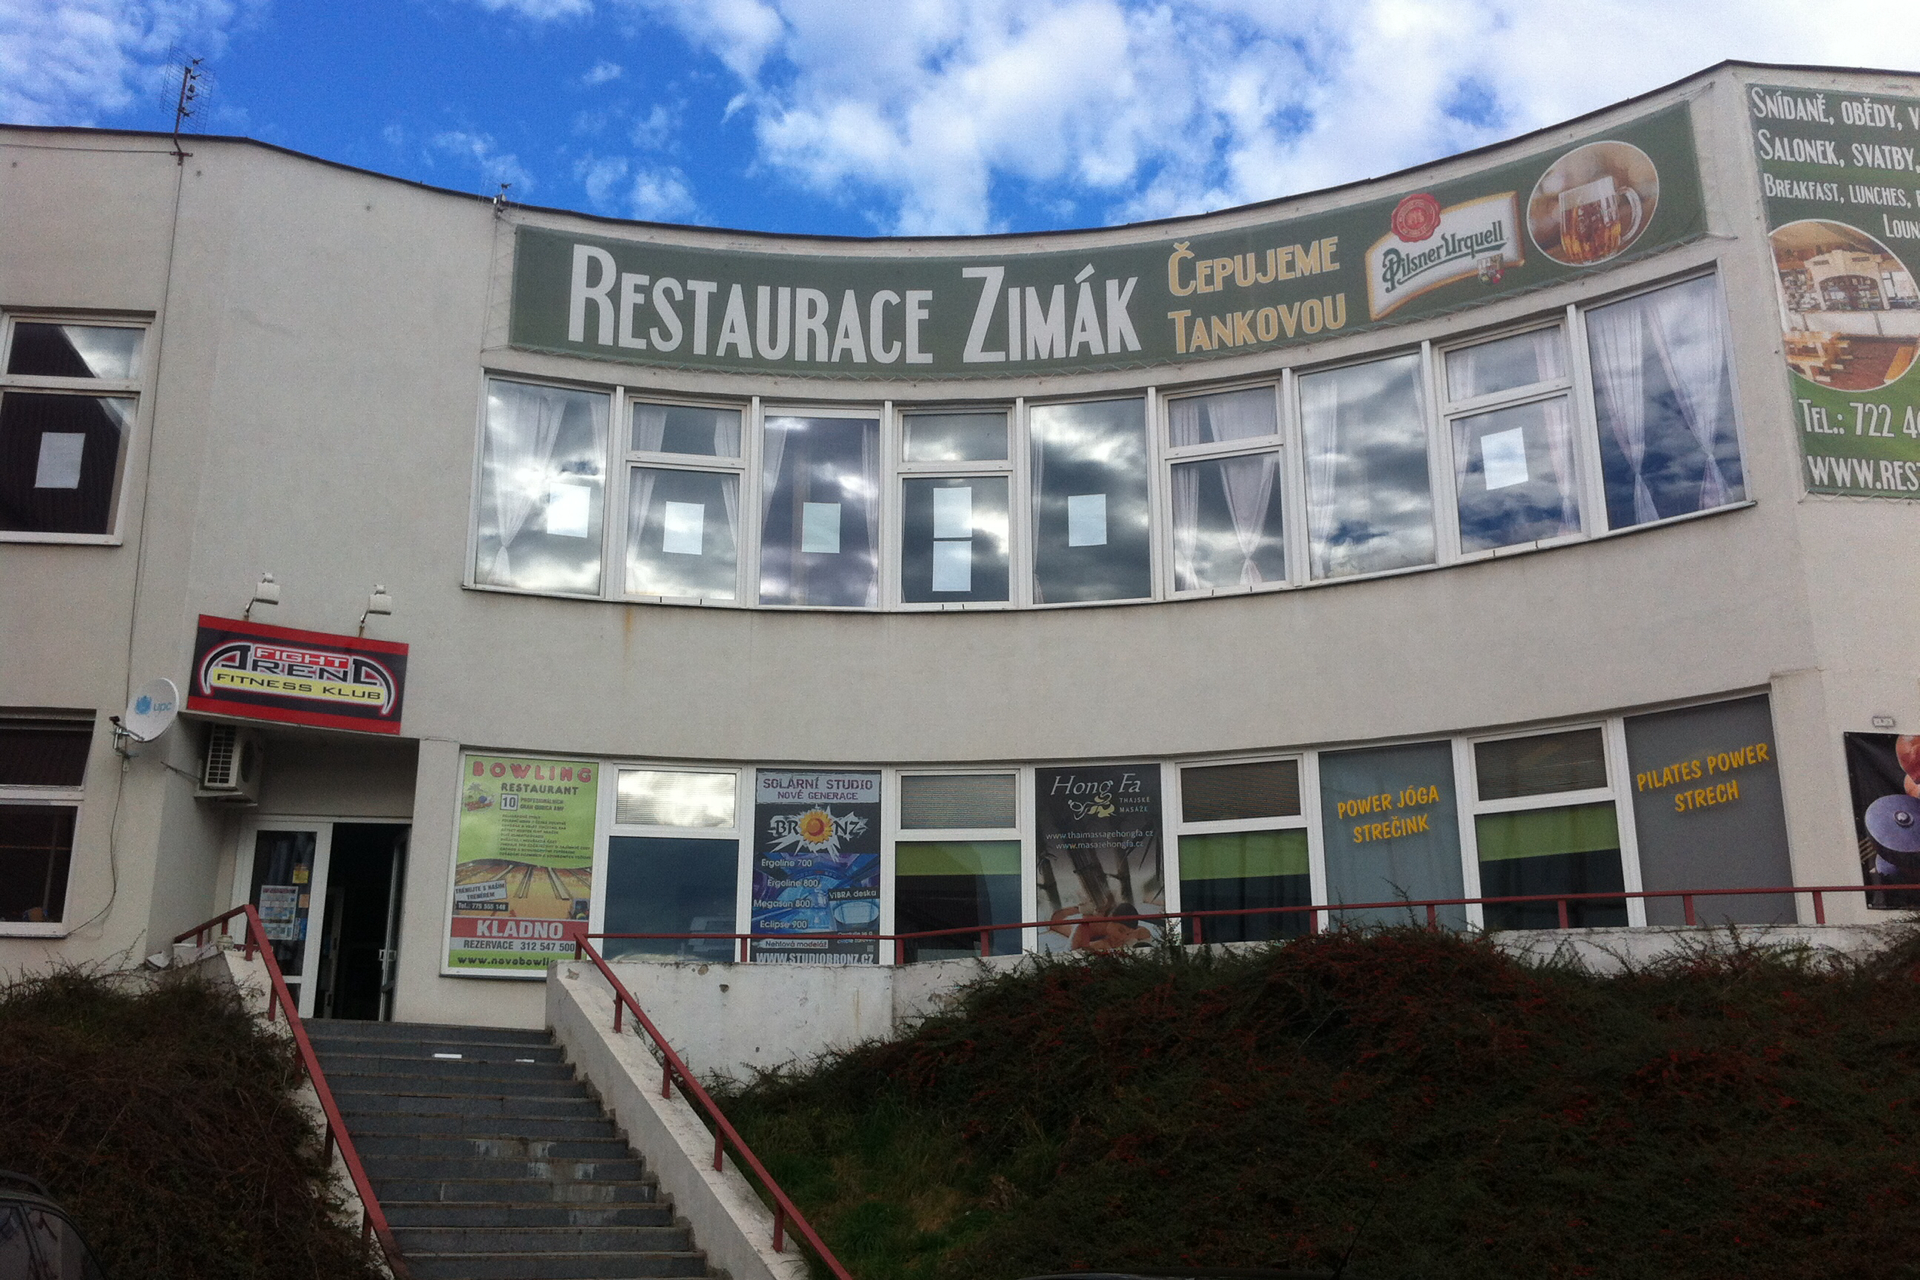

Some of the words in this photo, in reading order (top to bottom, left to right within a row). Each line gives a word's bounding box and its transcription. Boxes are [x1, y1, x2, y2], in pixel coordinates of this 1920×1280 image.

[1751, 86, 1835, 126] SNÍDANĚ,
[1841, 97, 1903, 131] OBĚDY,
[1757, 128, 1845, 168] SALONEK,
[1851, 143, 1920, 174] SVATBY,
[1763, 172, 1845, 204] BREAKFAST,
[1848, 184, 1912, 209] LUNCHES,
[1883, 213, 1920, 239] LOUN
[1167, 236, 1341, 297] ČEPUJEME
[1382, 243, 1444, 293] Pilsner
[1441, 220, 1505, 259] Urquell
[568, 243, 934, 365] RESTAURACE
[962, 262, 1142, 364] ZIMÁK
[1167, 292, 1347, 355] TANKOVOU
[1798, 398, 1845, 435] TEL.:
[1849, 402, 1895, 437] 722
[256, 647, 348, 668] FIGHT
[203, 643, 394, 713] ARENA
[216, 673, 313, 693] FITNESS
[322, 686, 381, 700] KLUB
[472, 760, 592, 783] BOWLING
[1636, 760, 1702, 792] PILATES
[1707, 742, 1770, 775] POWER
[501, 782, 579, 796] RESTAURANT
[763, 776, 820, 790] SOLÁRNÍ
[826, 779, 873, 790] STUDIO
[777, 789, 803, 800] NOVÉ
[808, 791, 859, 801] GENERACE
[1050, 775, 1114, 798] Hong
[1118, 772, 1141, 793] Fa
[1674, 779, 1740, 812] STRECH
[503, 796, 516, 808] 10
[1337, 793, 1393, 819] POWER
[1397, 784, 1440, 808] JÓGA
[1353, 813, 1430, 843] STREČINK
[761, 858, 795, 869] Ergoline
[796, 858, 812, 868] 700
[767, 878, 802, 889] Ergoline
[803, 879, 819, 888] 800
[829, 891, 852, 900] VIBRA
[853, 889, 877, 898] deska
[476, 919, 564, 939] KLADNO
[759, 919, 790, 930] Eclipse
[792, 920, 807, 929] 900
[463, 940, 514, 950] REZERVACE
[520, 941, 537, 951] 312
[540, 942, 556, 951] 547
[558, 943, 575, 952] 500
[756, 952, 874, 965] WWW.STUDIOBRONZ.CZ
[457, 956, 556, 967] www.novobowli
